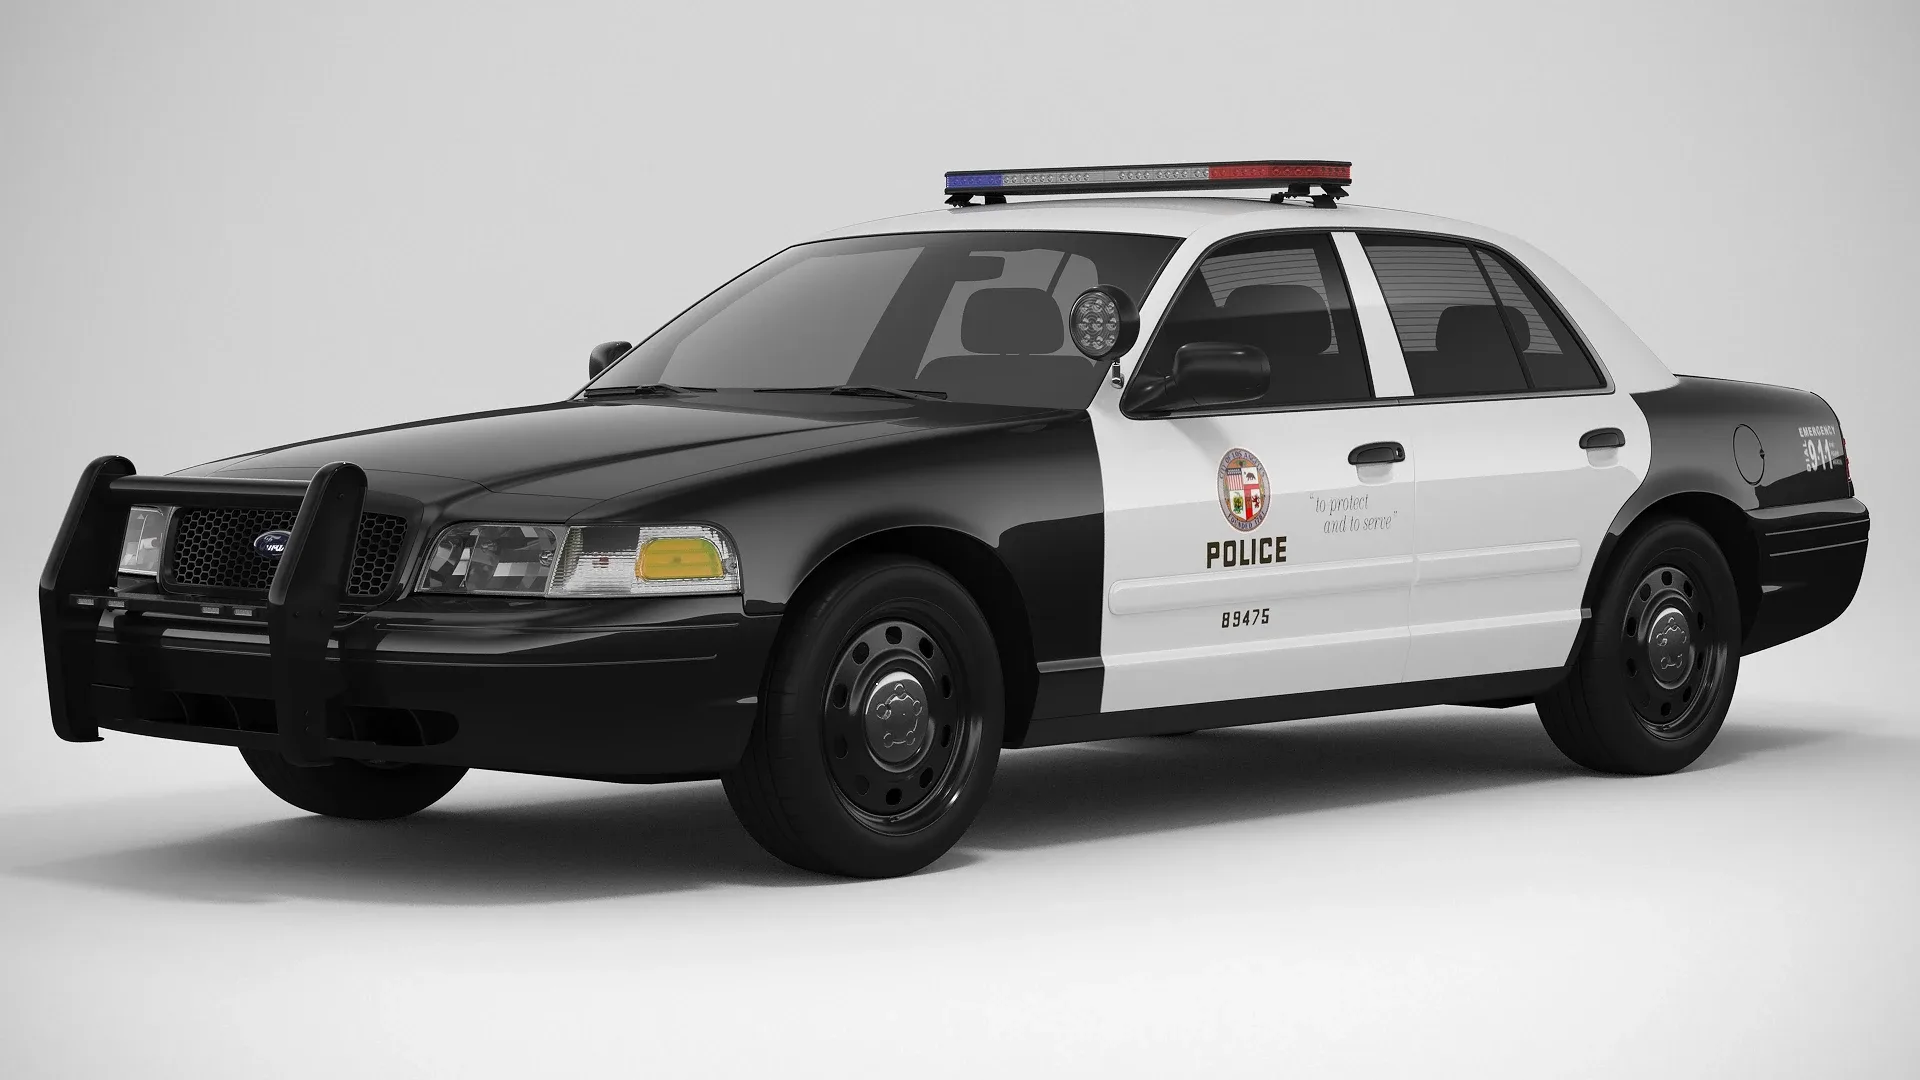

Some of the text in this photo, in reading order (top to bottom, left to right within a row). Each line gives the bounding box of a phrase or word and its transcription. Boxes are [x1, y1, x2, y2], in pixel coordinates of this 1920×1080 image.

[1798, 425, 1835, 437] EMERGENCY
[1329, 493, 1369, 516] protect
[1323, 514, 1347, 534] and
[1349, 515, 1361, 532] to
[1206, 536, 1287, 569] POLICE
[1221, 608, 1270, 629] 89475
